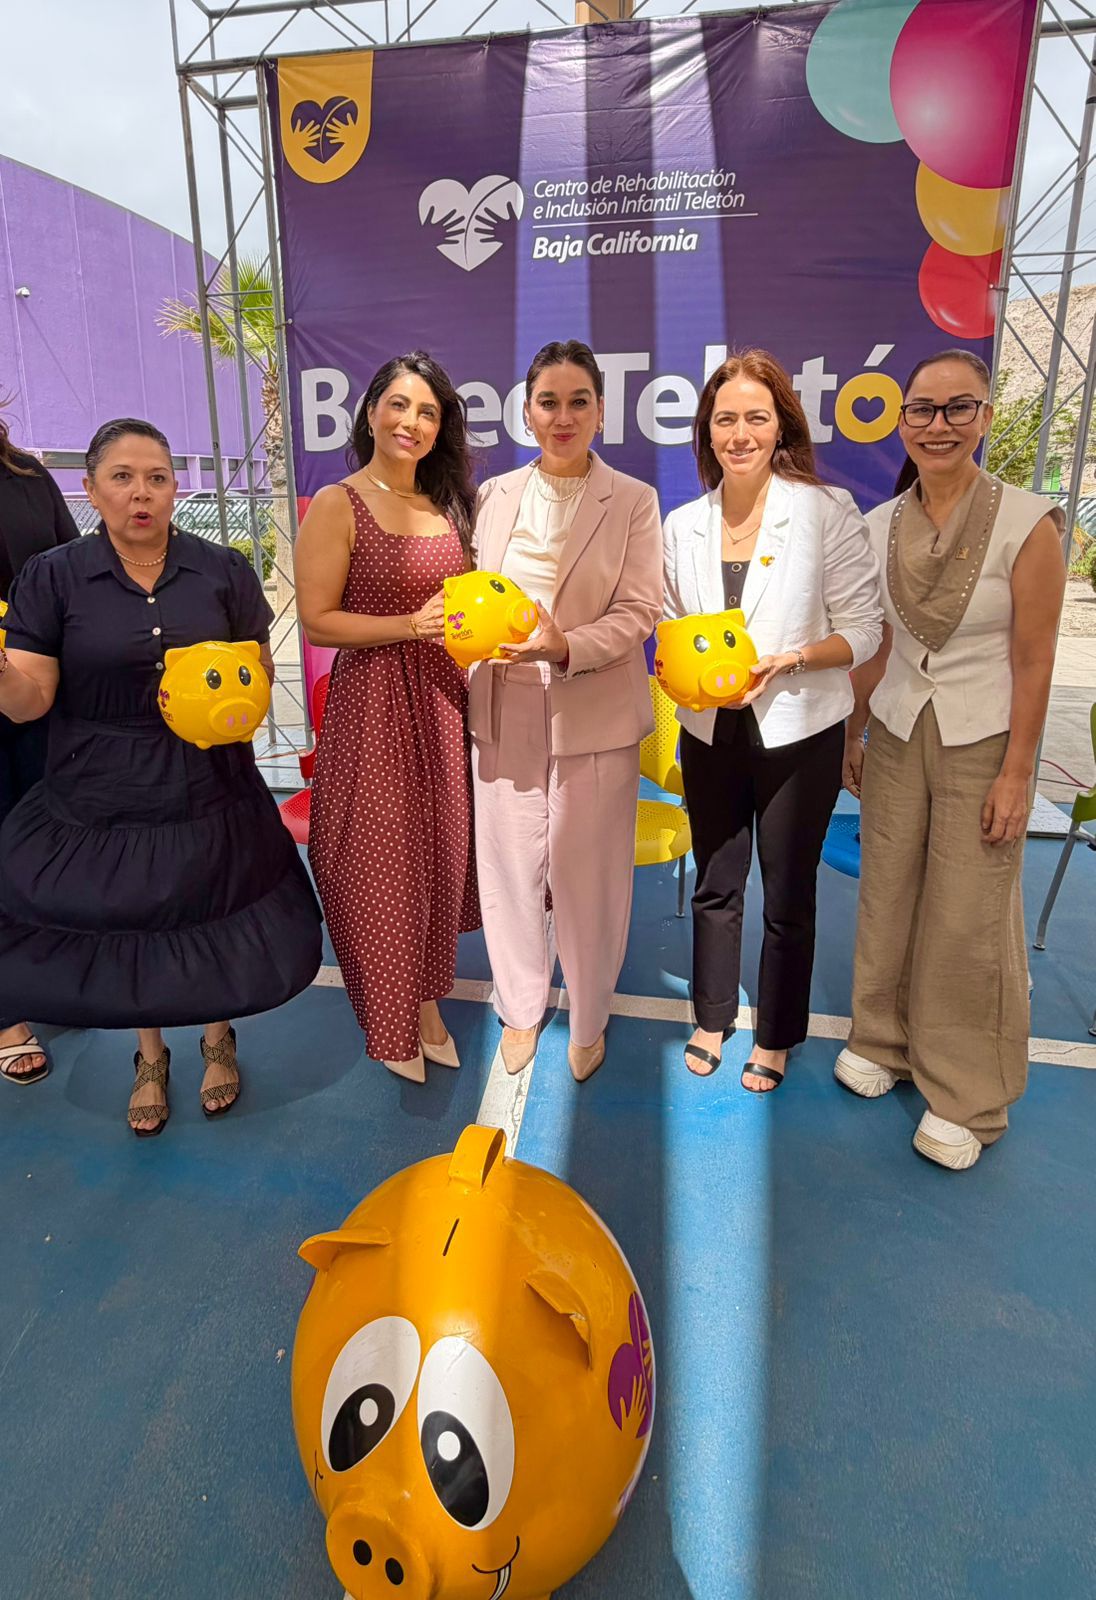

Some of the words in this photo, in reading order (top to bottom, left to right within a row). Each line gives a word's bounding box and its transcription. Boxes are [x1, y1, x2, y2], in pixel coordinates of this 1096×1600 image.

[534, 179, 589, 198] Centro
[591, 176, 612, 193] de
[614, 168, 736, 192] Rehabilitación
[533, 206, 544, 219] e
[545, 197, 618, 219] Inclusión
[621, 192, 682, 214] Infantil
[684, 189, 746, 210] Teletón
[532, 235, 583, 263] Baja
[586, 228, 699, 255] California
